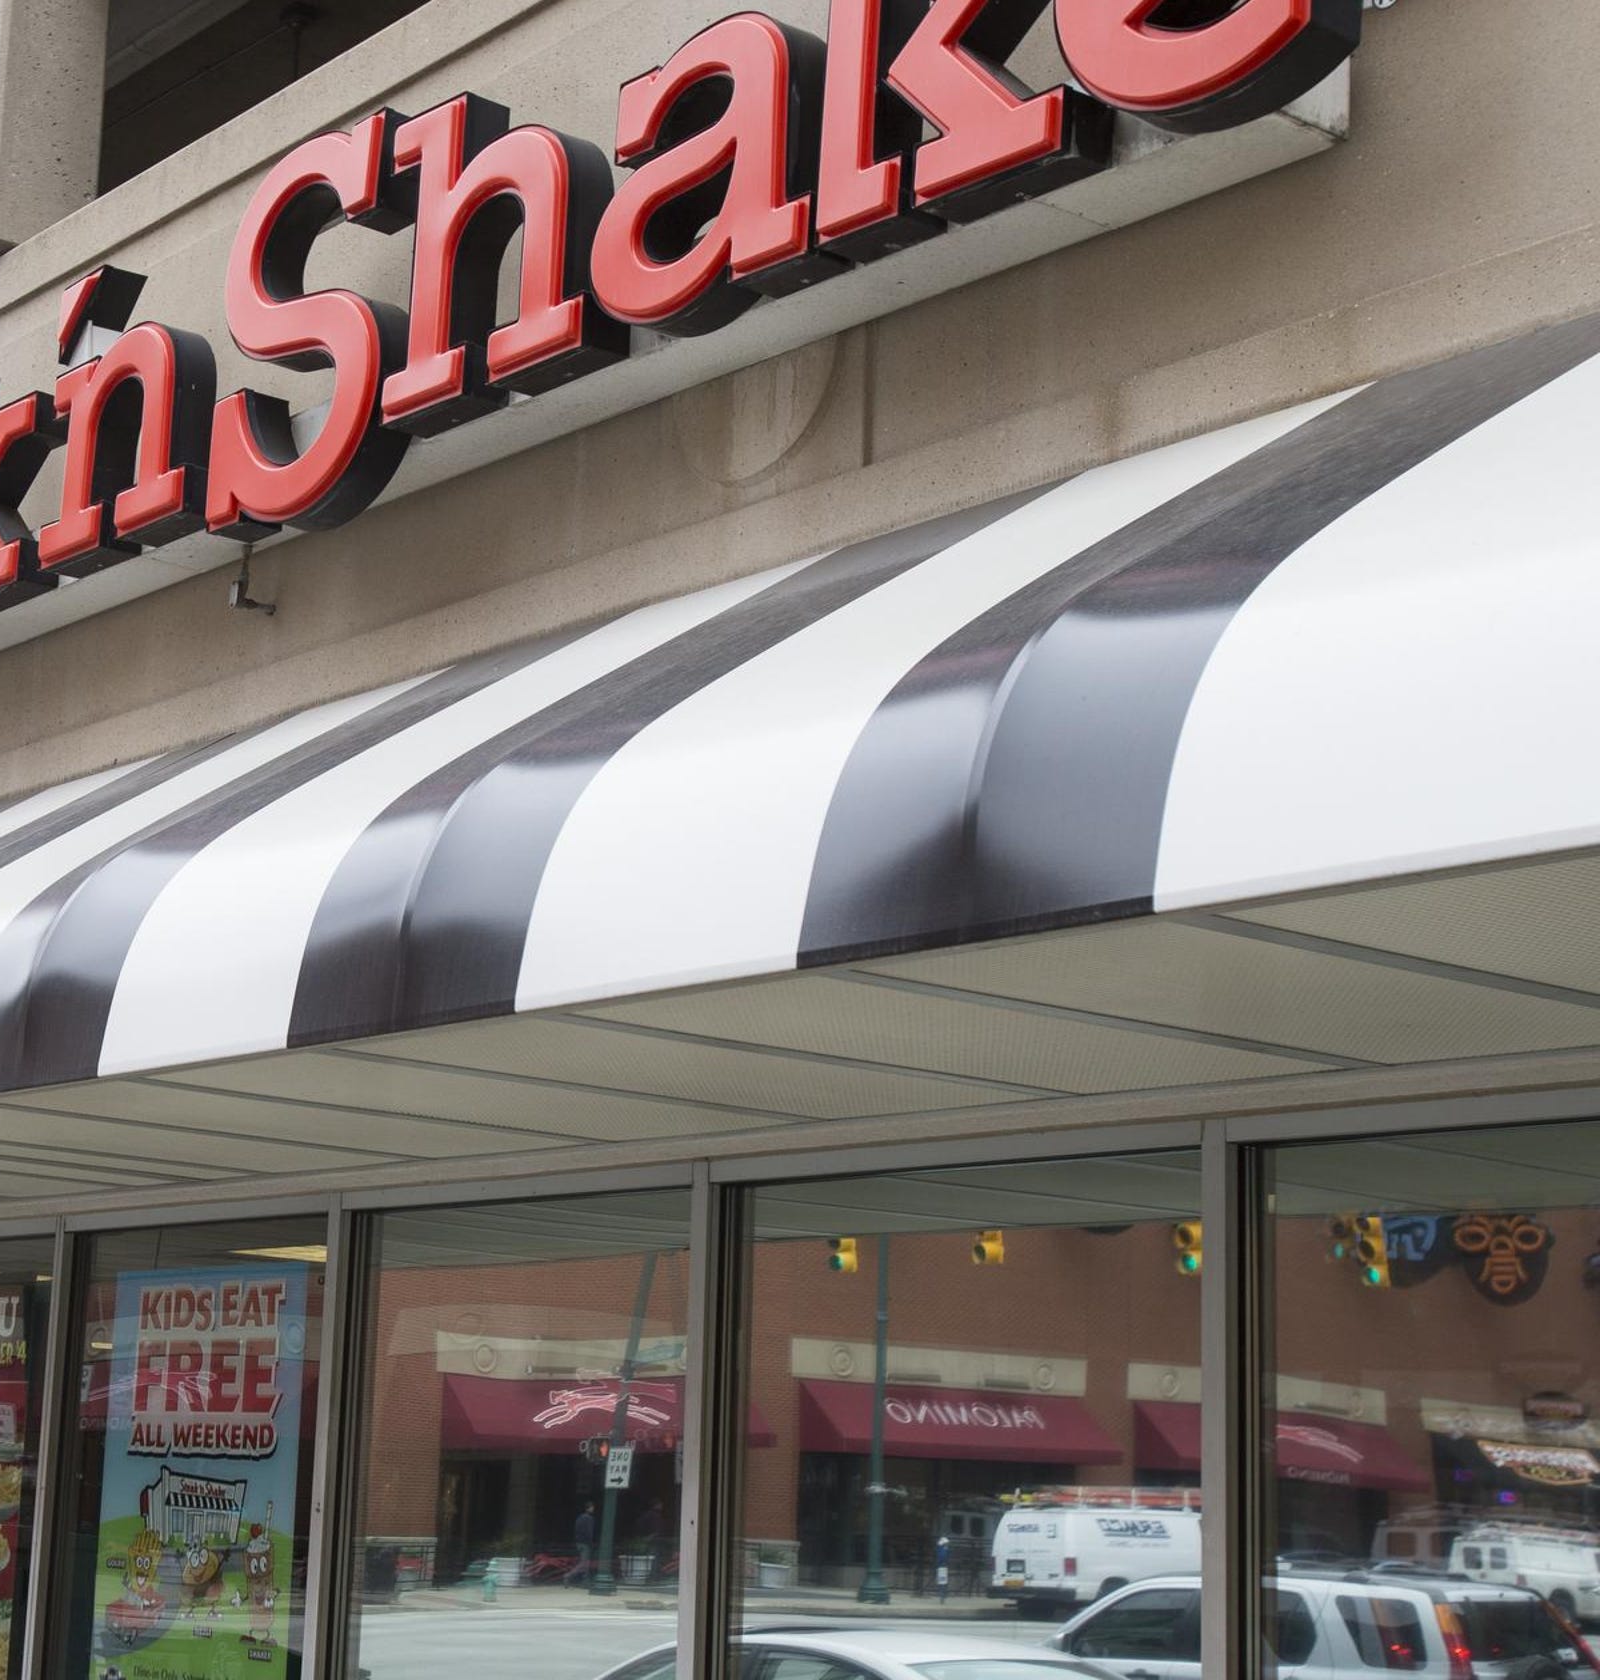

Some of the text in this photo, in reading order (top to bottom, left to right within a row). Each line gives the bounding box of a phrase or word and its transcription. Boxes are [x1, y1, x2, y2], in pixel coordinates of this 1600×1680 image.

[140, 1282, 284, 1331] KIDS EAT
[134, 1338, 279, 1413] FREE
[131, 1422, 168, 1448] ALL
[172, 1423, 275, 1450] WEEKEND
